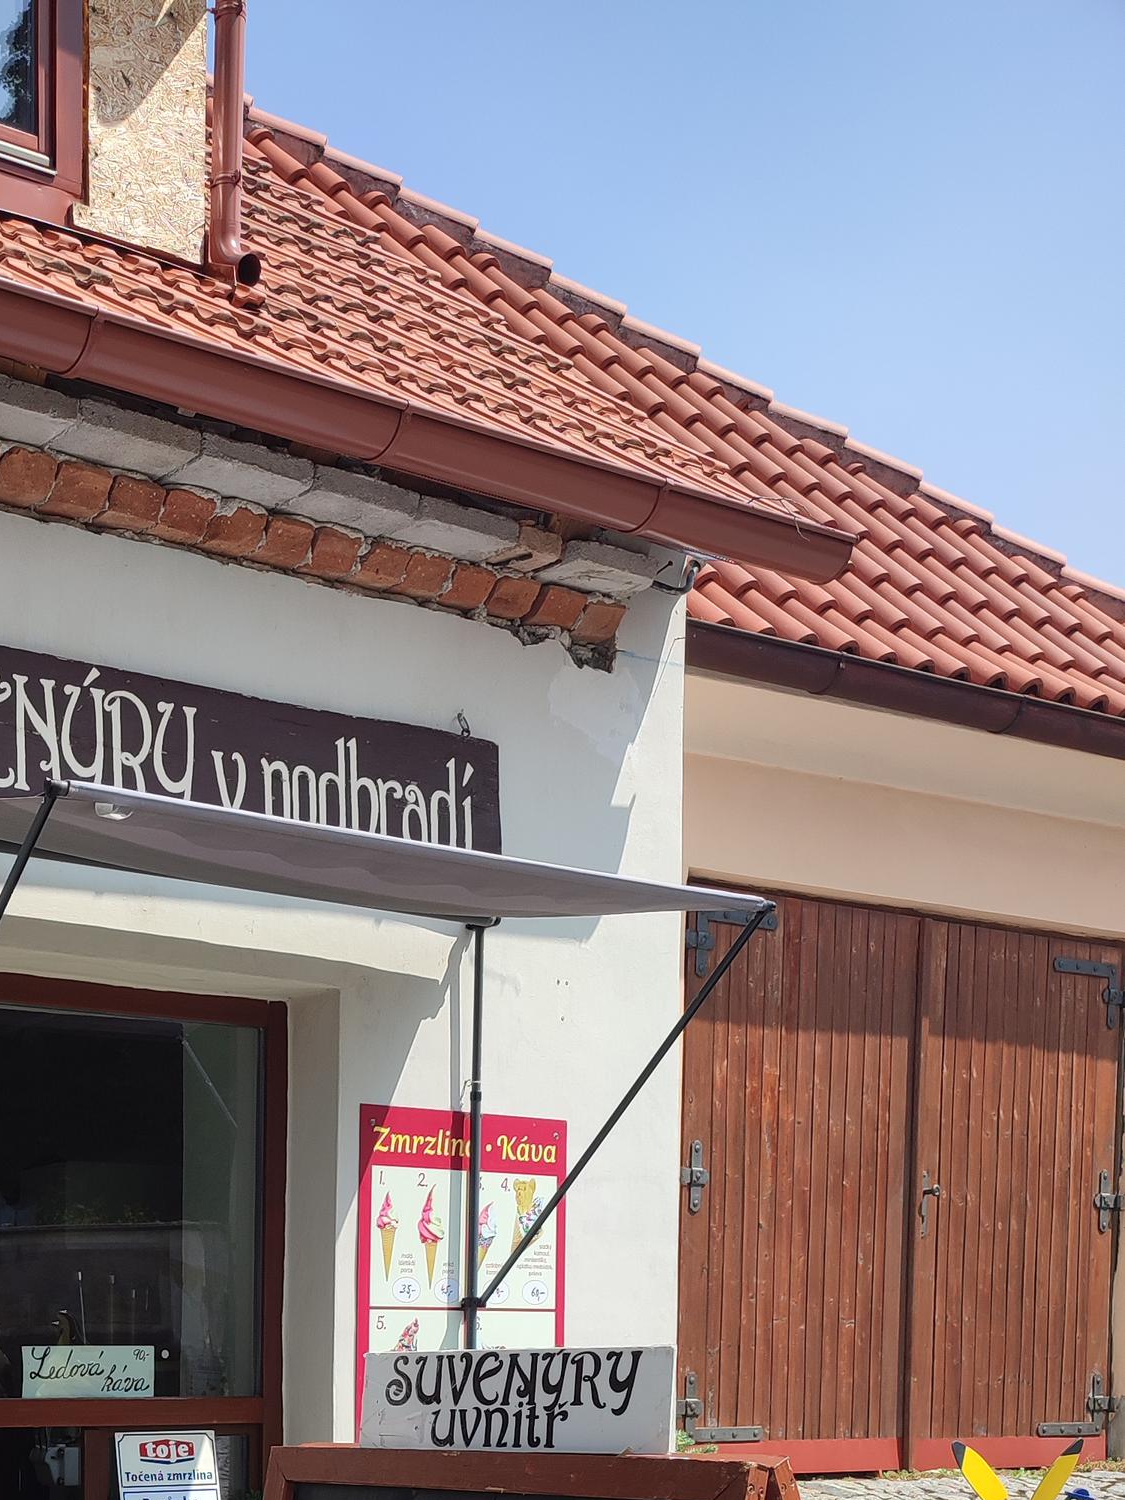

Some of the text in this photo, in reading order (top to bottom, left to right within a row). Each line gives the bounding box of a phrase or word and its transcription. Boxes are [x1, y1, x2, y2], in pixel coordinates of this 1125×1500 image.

[211, 750, 247, 809] v
[497, 1135, 557, 1163] Káva
[417, 1173, 428, 1187] 2.
[501, 1178, 511, 1192] 4.
[376, 1315, 386, 1330] 5.
[30, 1346, 105, 1379] Ledová
[101, 1364, 150, 1392] káva
[385, 1349, 643, 1416] SUVENÝRY
[431, 1401, 569, 1449] uvnitř
[145, 1440, 189, 1463] toje
[125, 1469, 213, 1482] Točená zmrzlina
